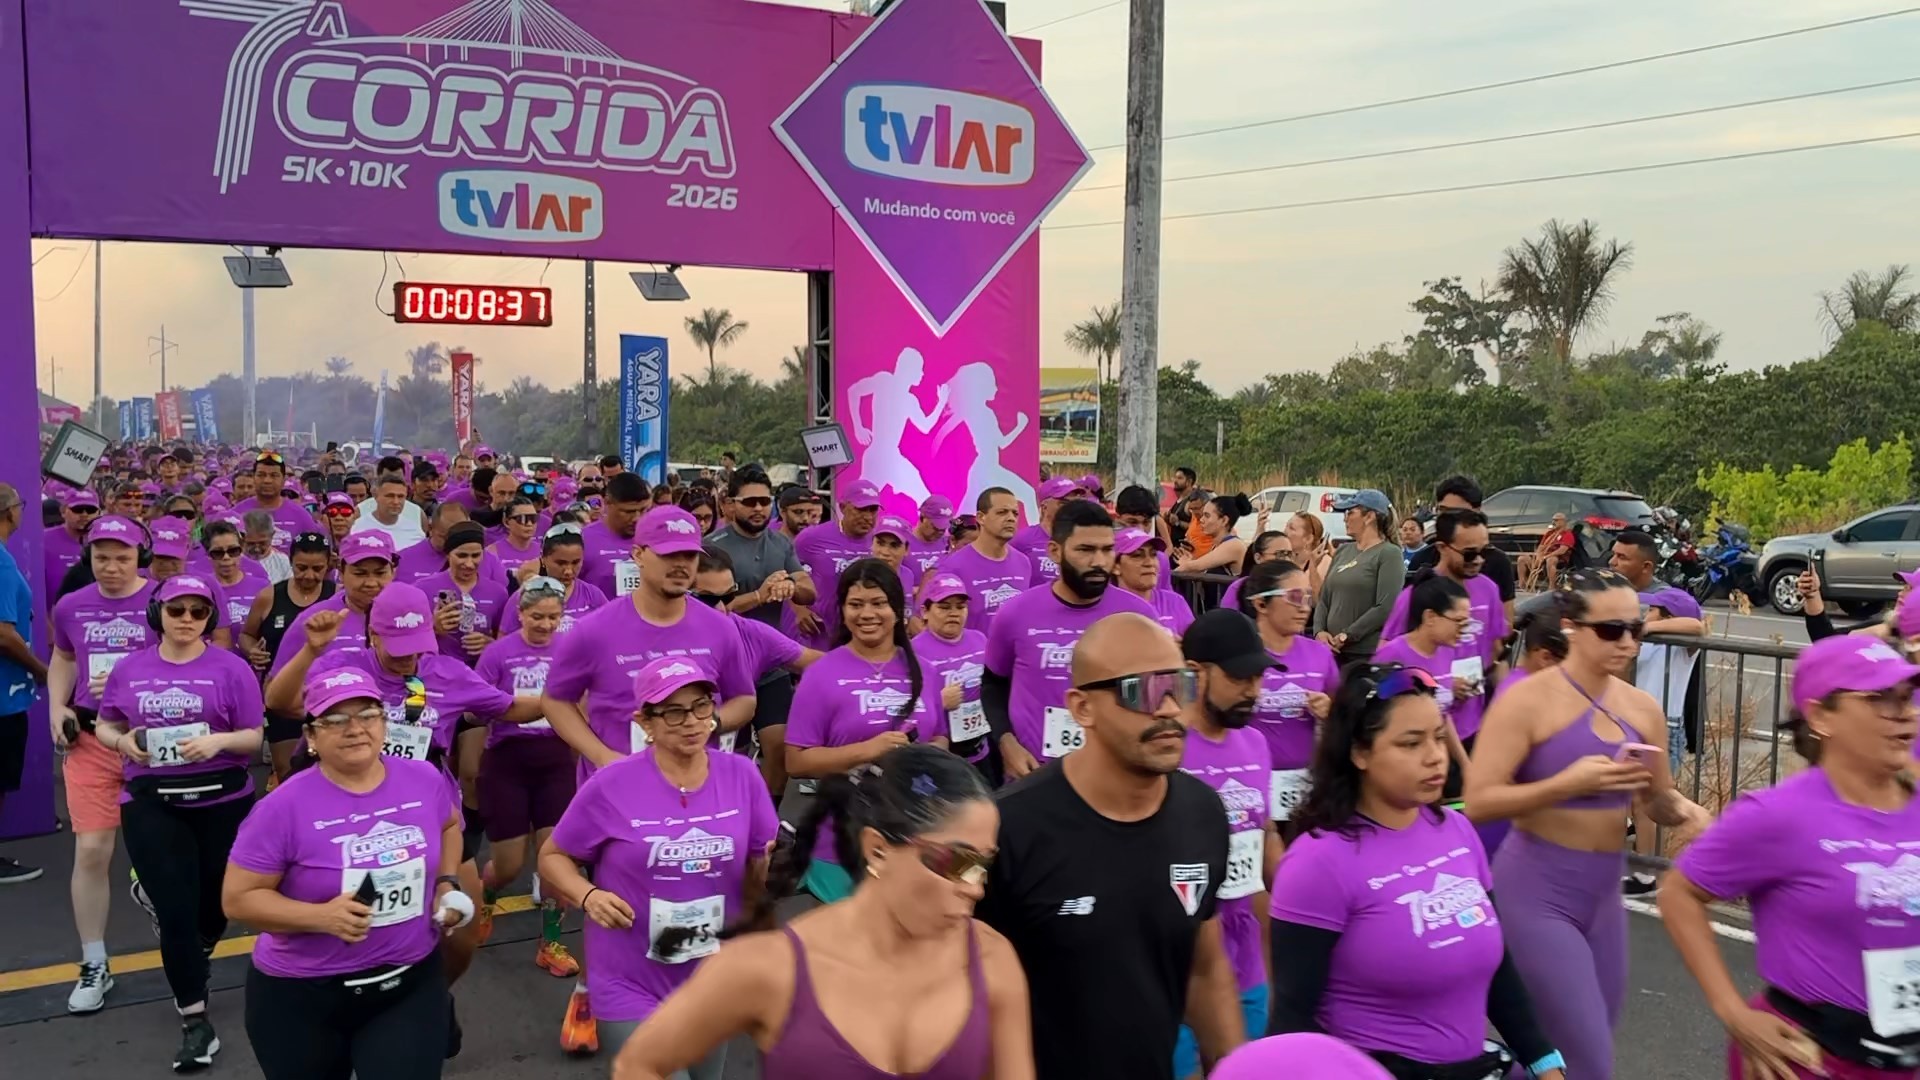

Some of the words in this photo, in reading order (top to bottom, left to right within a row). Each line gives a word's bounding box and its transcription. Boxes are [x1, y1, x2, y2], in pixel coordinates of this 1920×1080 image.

[273, 49, 736, 178] CORRIDA
[667, 183, 738, 211] 2026
[864, 197, 941, 219] Mudando
[943, 208, 977, 222] com
[980, 211, 1016, 225] você
[403, 287, 546, 321] 00:08:37
[459, 359, 472, 420] YARA
[635, 347, 662, 424] YARA
[624, 389, 634, 435] MINERAL
[64, 447, 95, 466] SMART
[811, 443, 838, 454] SMART
[658, 836, 735, 861] CORRIDA
